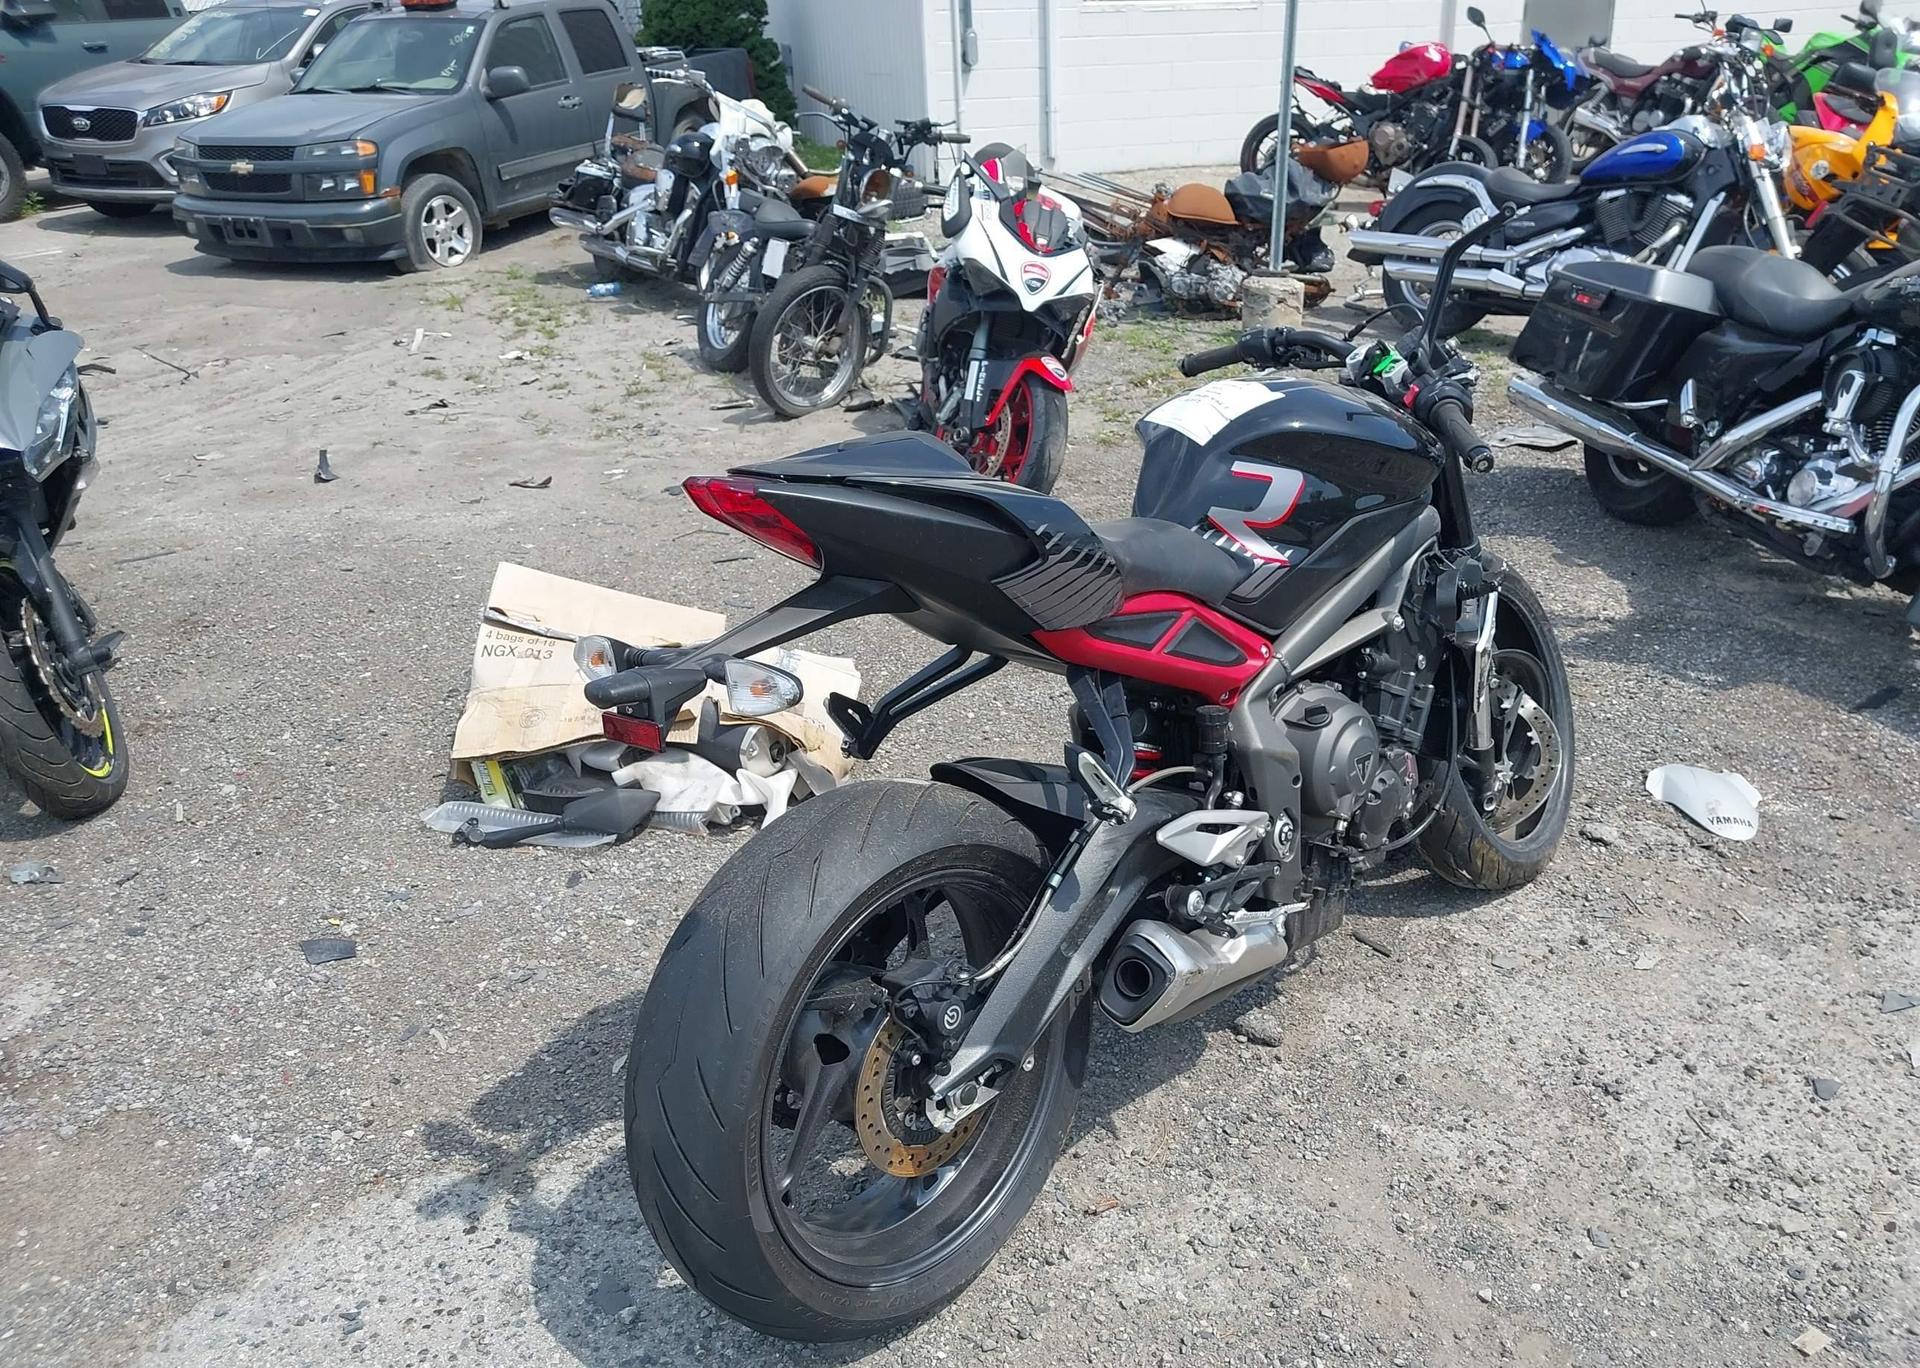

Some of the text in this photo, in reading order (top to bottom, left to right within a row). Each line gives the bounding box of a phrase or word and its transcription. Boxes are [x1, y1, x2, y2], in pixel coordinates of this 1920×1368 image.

[976, 360, 989, 402] PIRELLI
[485, 630, 492, 639] 4
[496, 631, 524, 643] bags
[481, 644, 518, 658] NGX
[1707, 815, 1754, 829] YAMAHA
